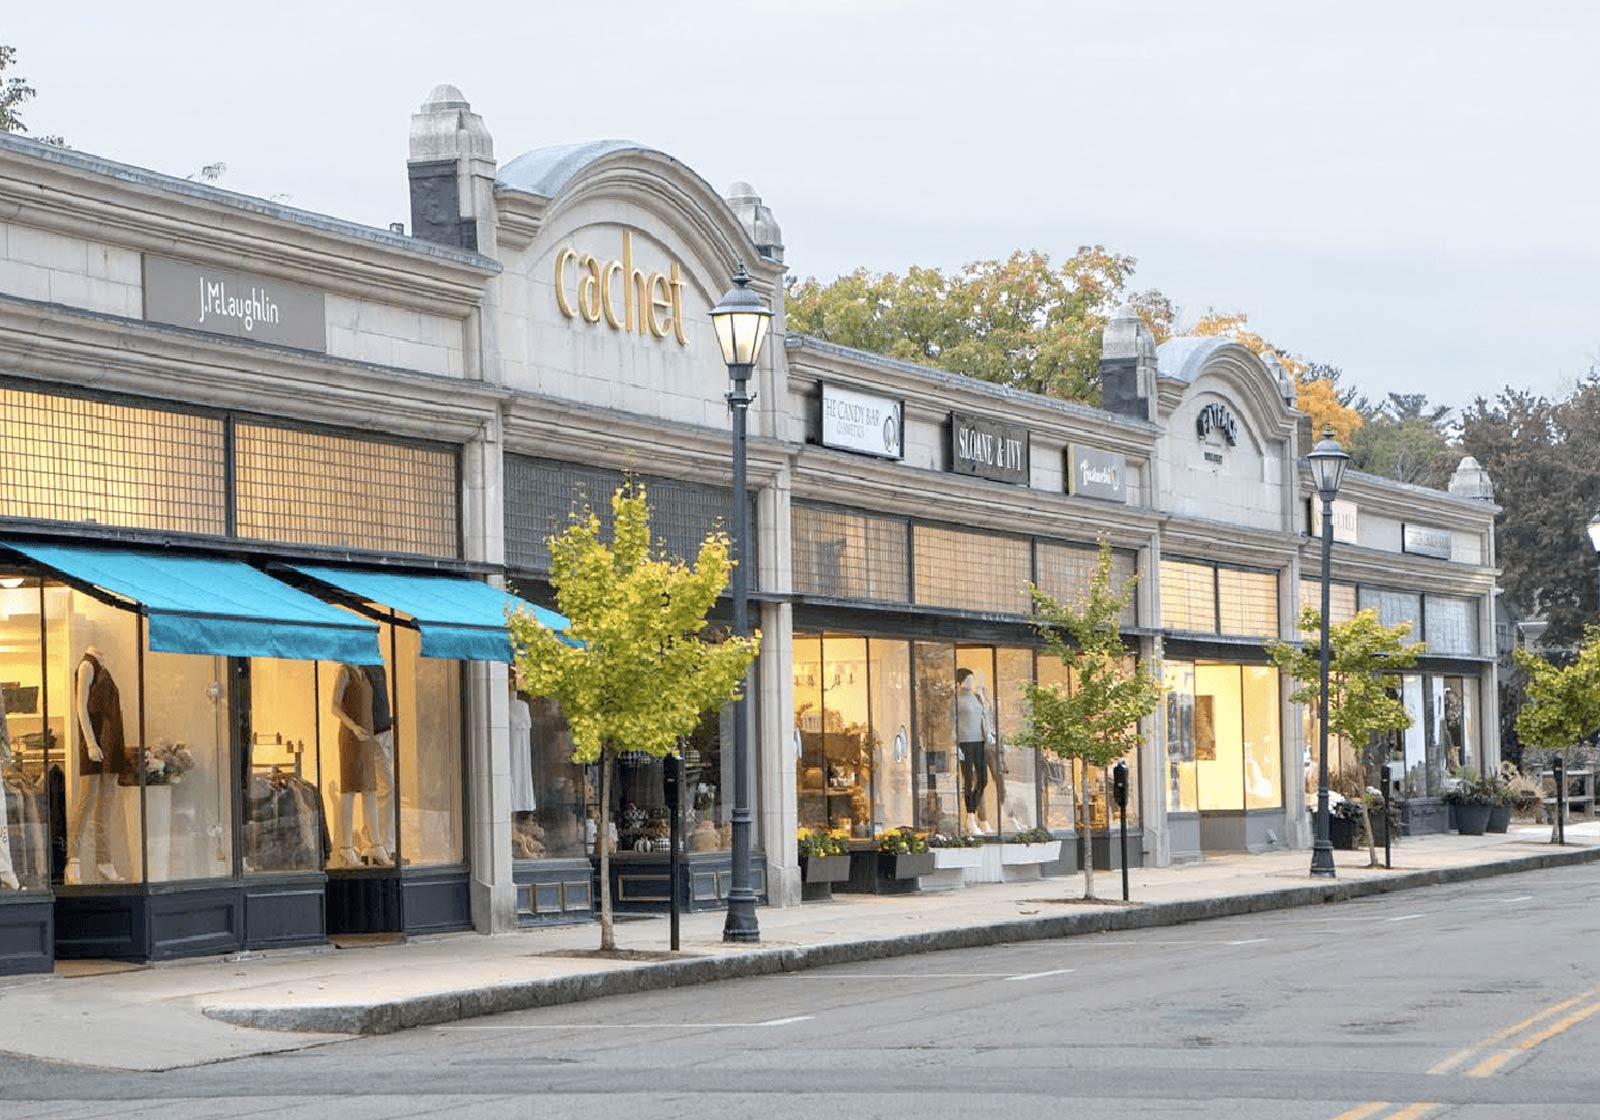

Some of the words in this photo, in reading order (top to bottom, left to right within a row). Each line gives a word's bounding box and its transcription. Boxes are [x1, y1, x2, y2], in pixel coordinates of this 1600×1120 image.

[555, 228, 691, 346] cachet
[837, 401, 865, 424] CANDY
[959, 427, 993, 466] SLOANE
[997, 437, 1005, 468] &
[1006, 439, 1022, 472] IVY
